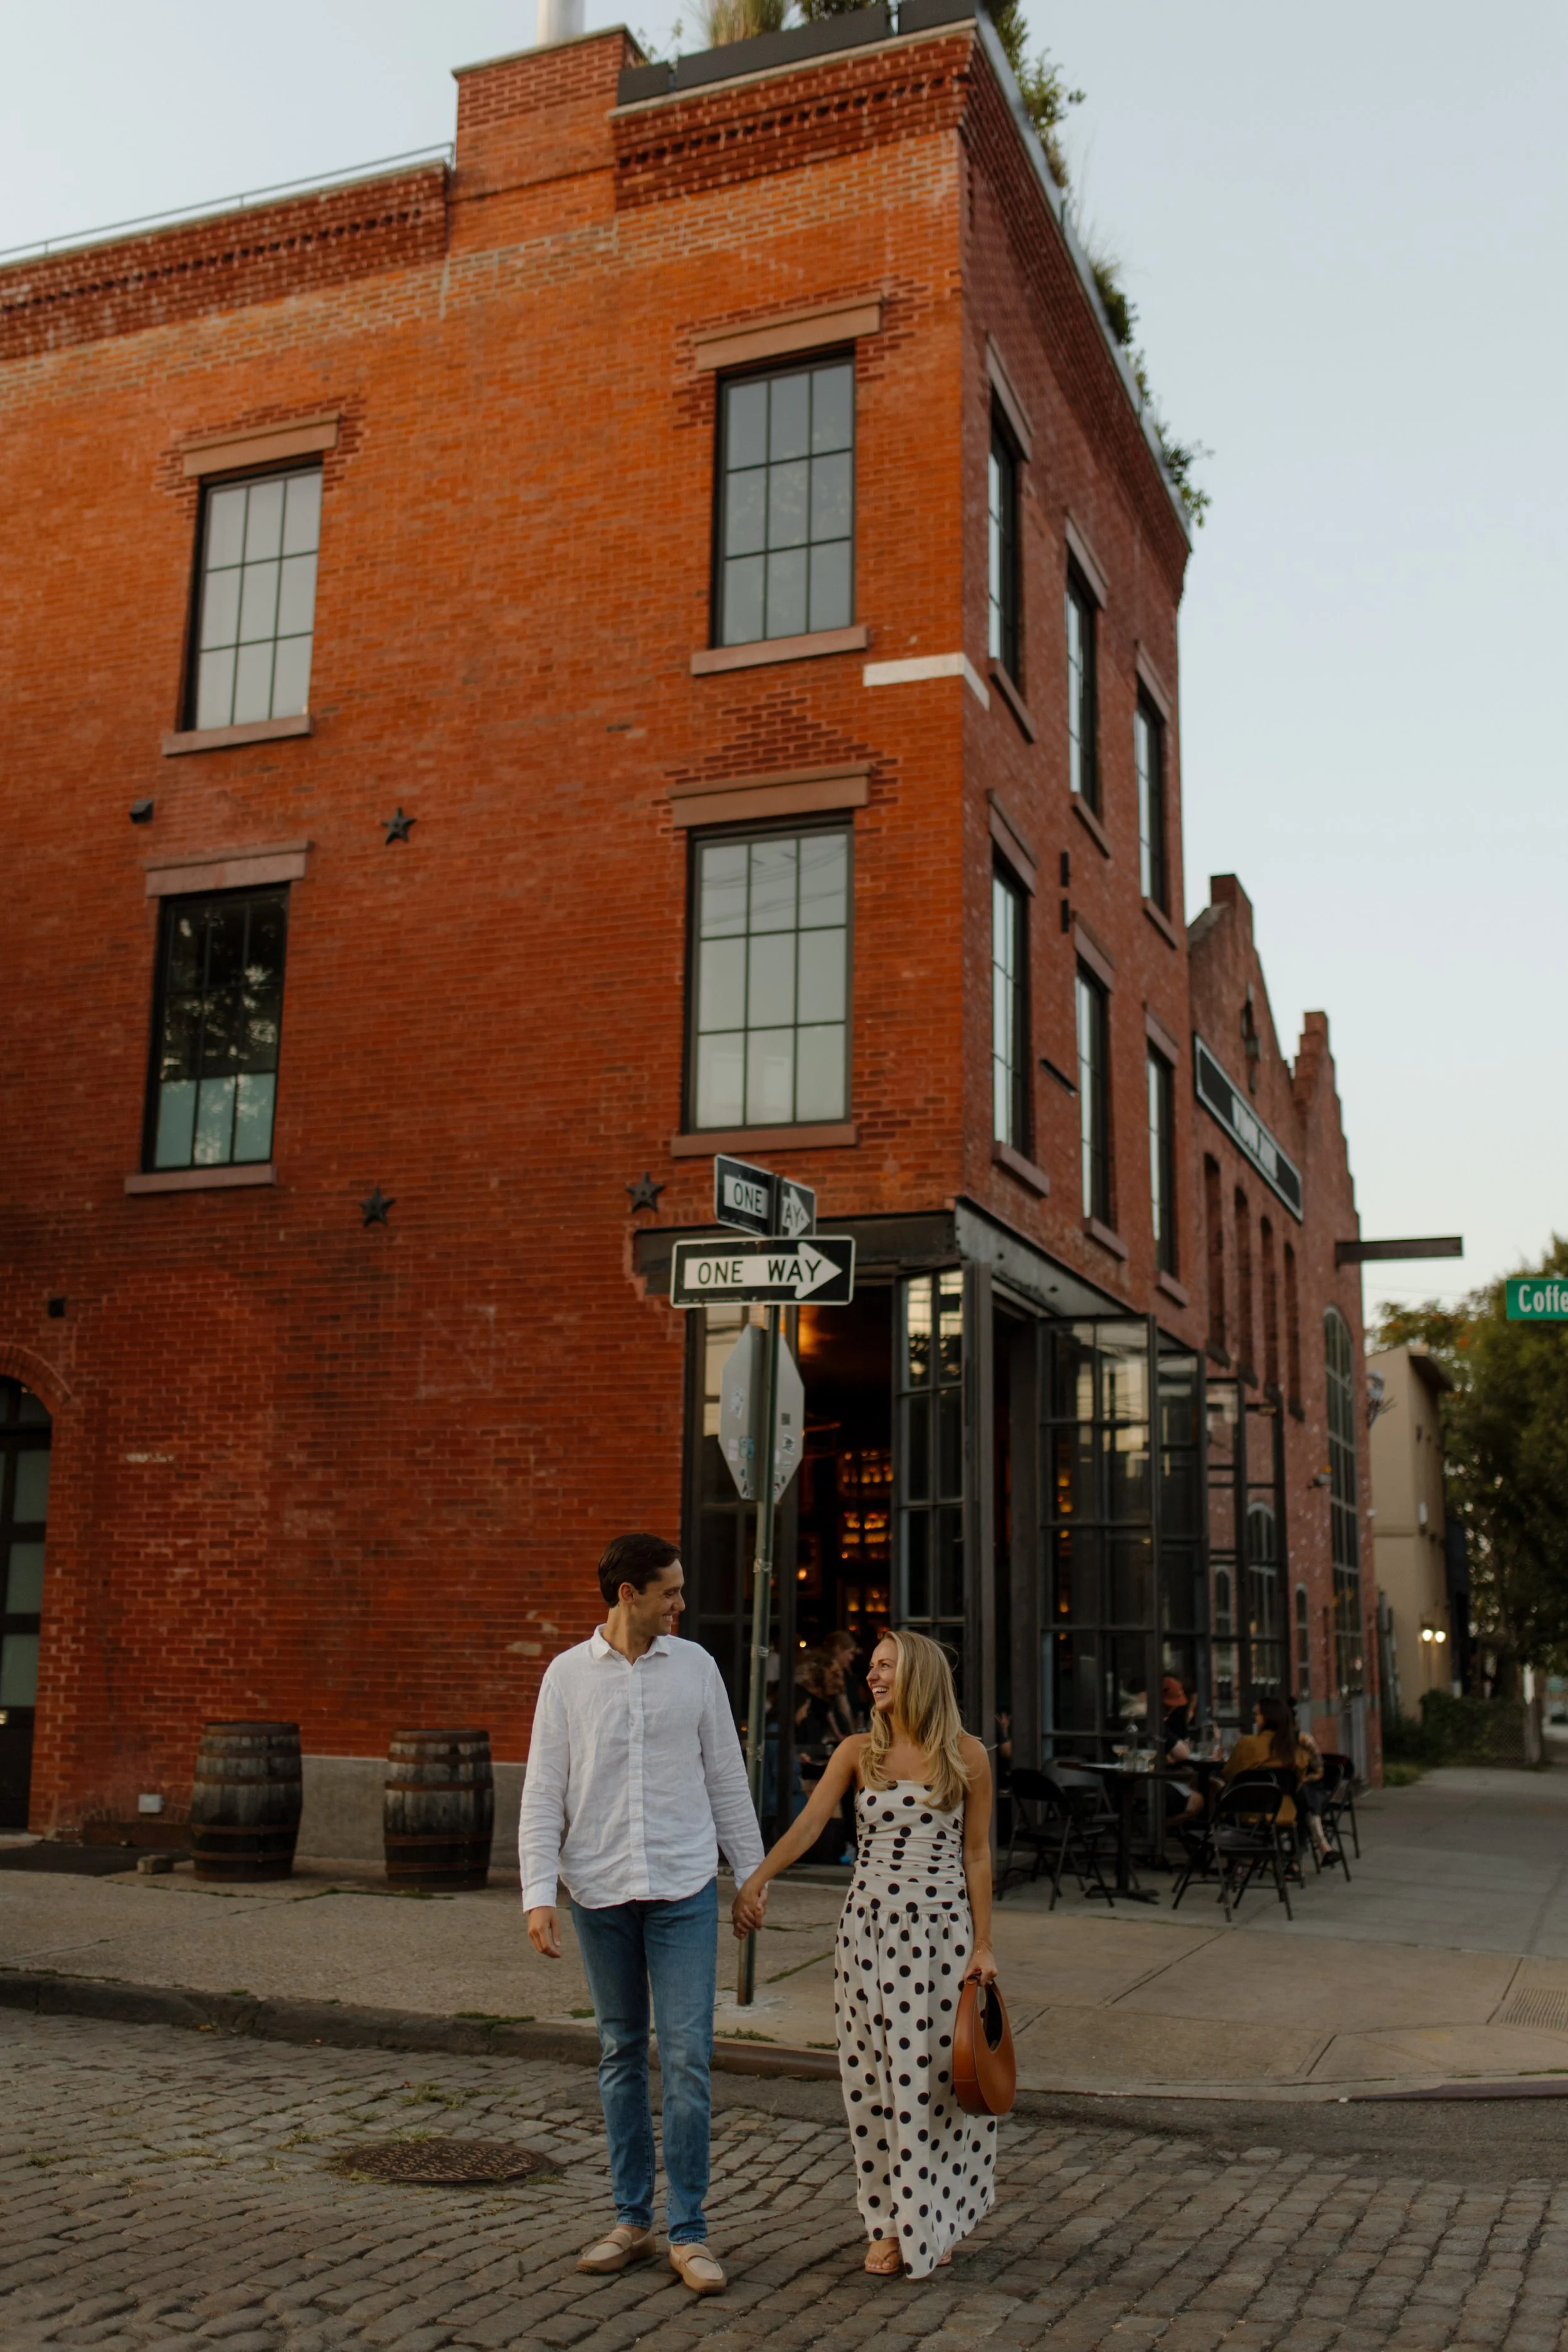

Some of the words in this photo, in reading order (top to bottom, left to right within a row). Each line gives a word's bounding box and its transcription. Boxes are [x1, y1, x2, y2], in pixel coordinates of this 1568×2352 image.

[734, 1183, 762, 1214] ONE
[783, 1202, 801, 1228] AY
[697, 1261, 743, 1285] ONE
[768, 1259, 822, 1283] WAY
